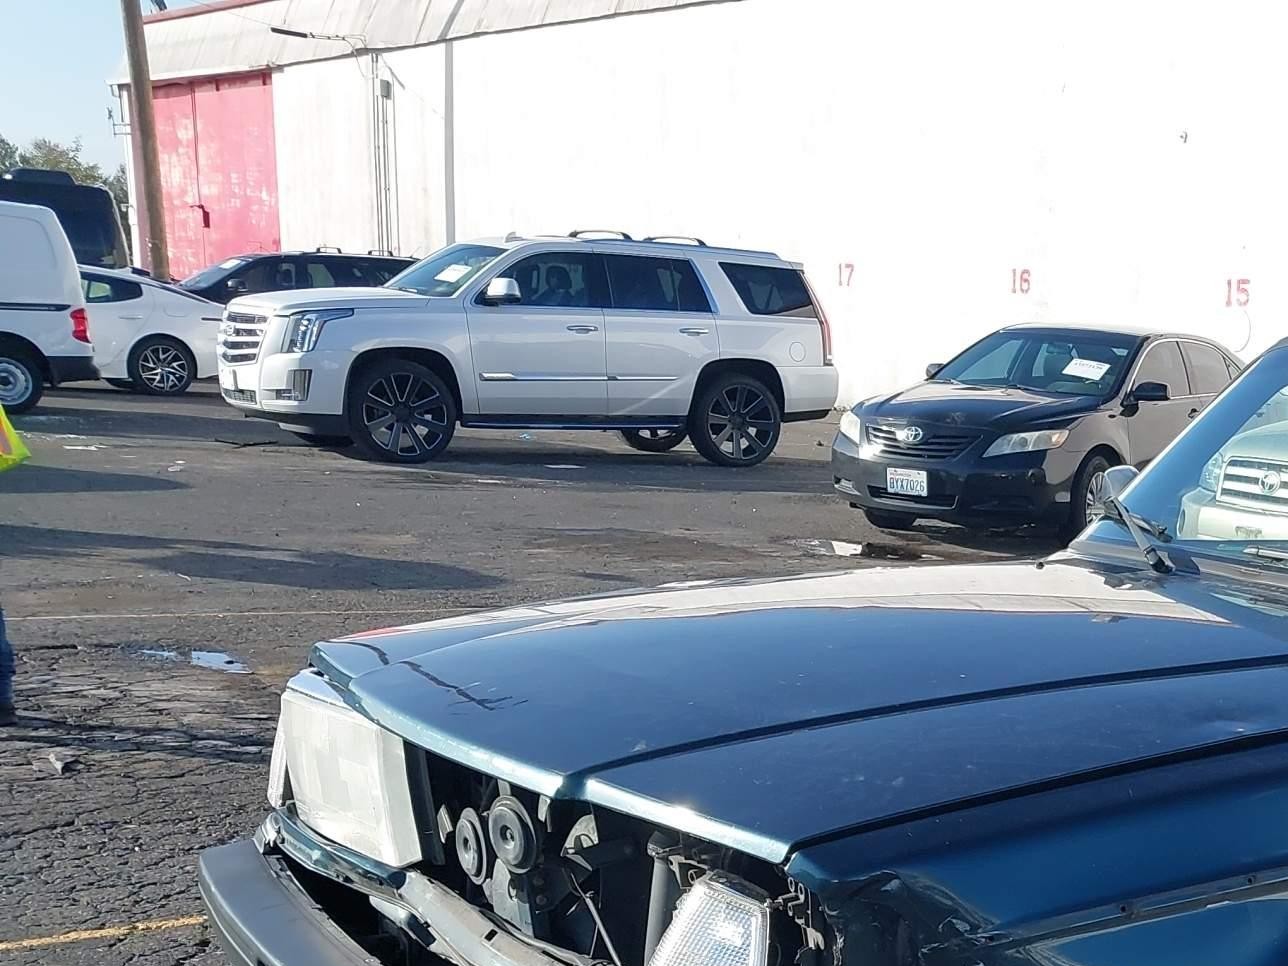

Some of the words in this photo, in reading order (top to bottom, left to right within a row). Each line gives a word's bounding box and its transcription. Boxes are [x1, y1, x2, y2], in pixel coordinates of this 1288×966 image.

[838, 263, 855, 287] 17
[1011, 268, 1031, 294] 16
[1226, 278, 1251, 307] 15
